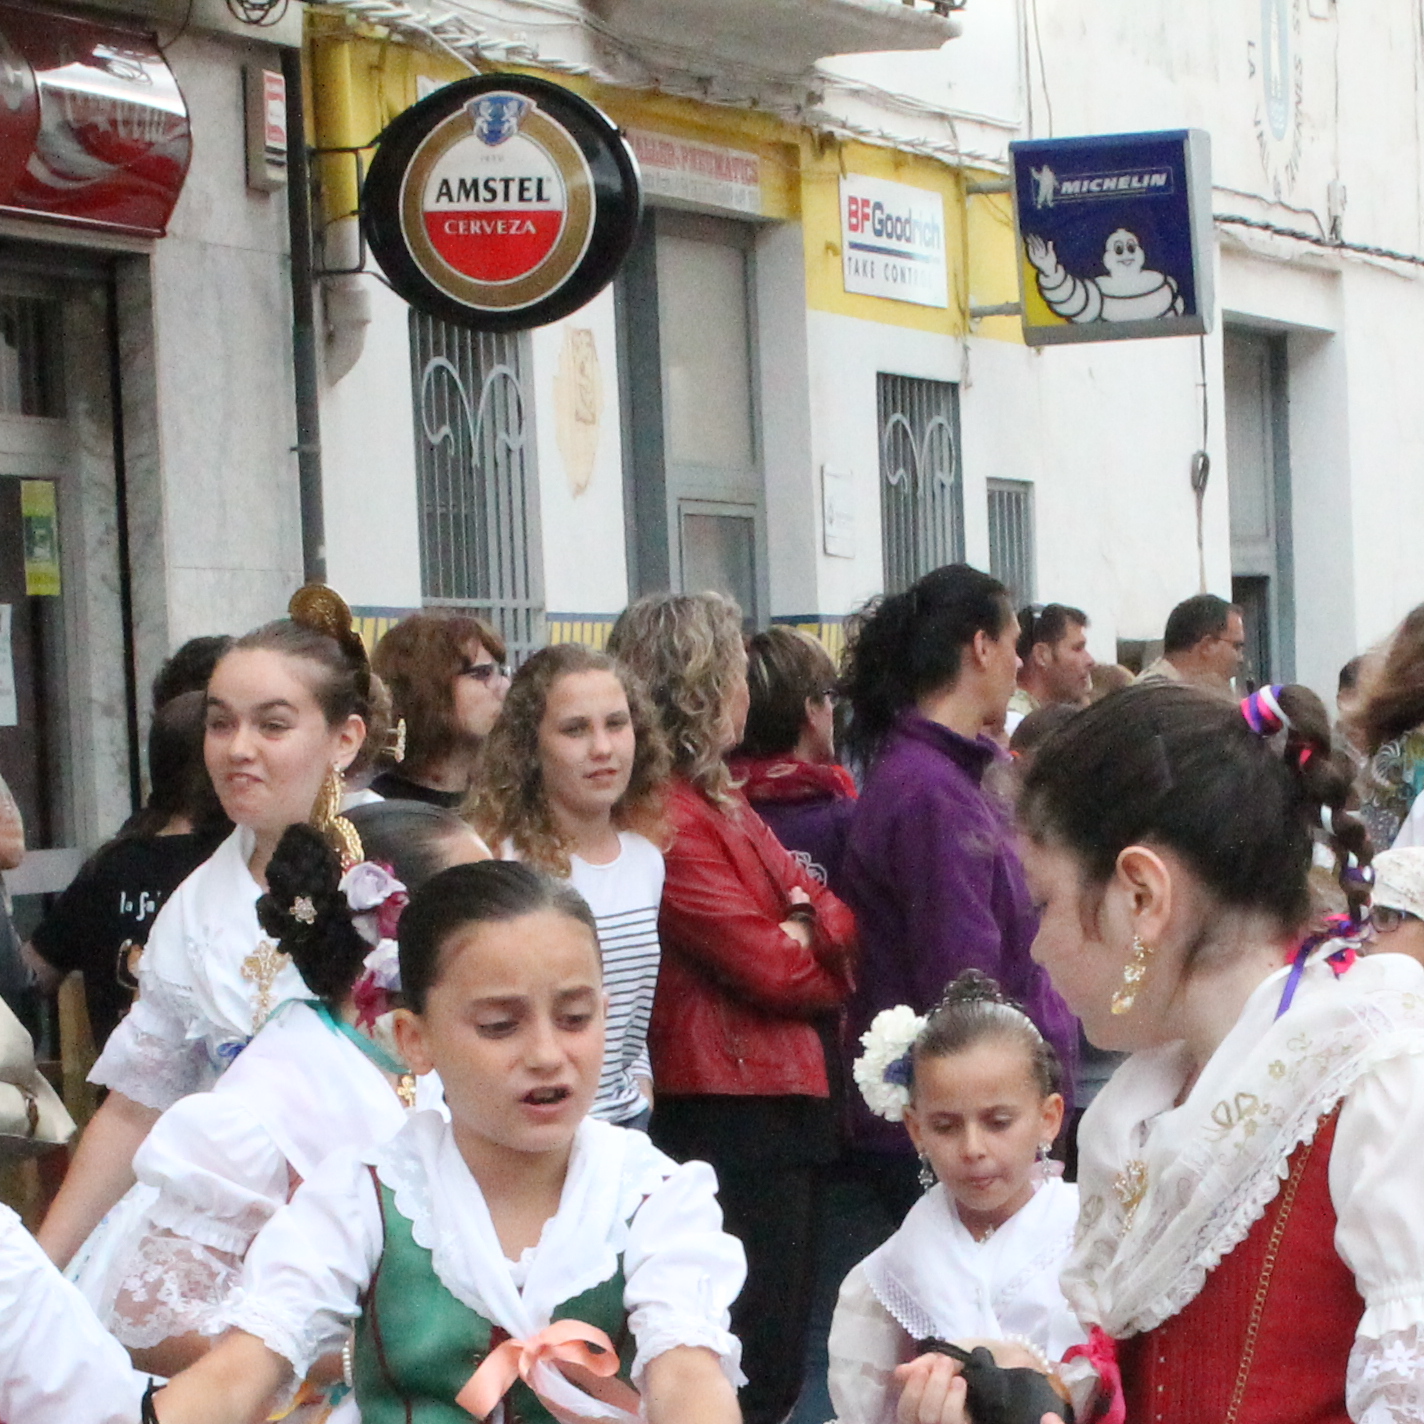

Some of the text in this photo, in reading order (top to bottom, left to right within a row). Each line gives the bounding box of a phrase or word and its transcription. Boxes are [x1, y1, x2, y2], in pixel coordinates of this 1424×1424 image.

[435, 177, 552, 203] AMSTEL
[1060, 173, 1168, 195] MICHELIN
[443, 219, 538, 235] CERVEZA
[847, 195, 941, 249] BFGoodrich
[847, 256, 875, 279] TAKE
